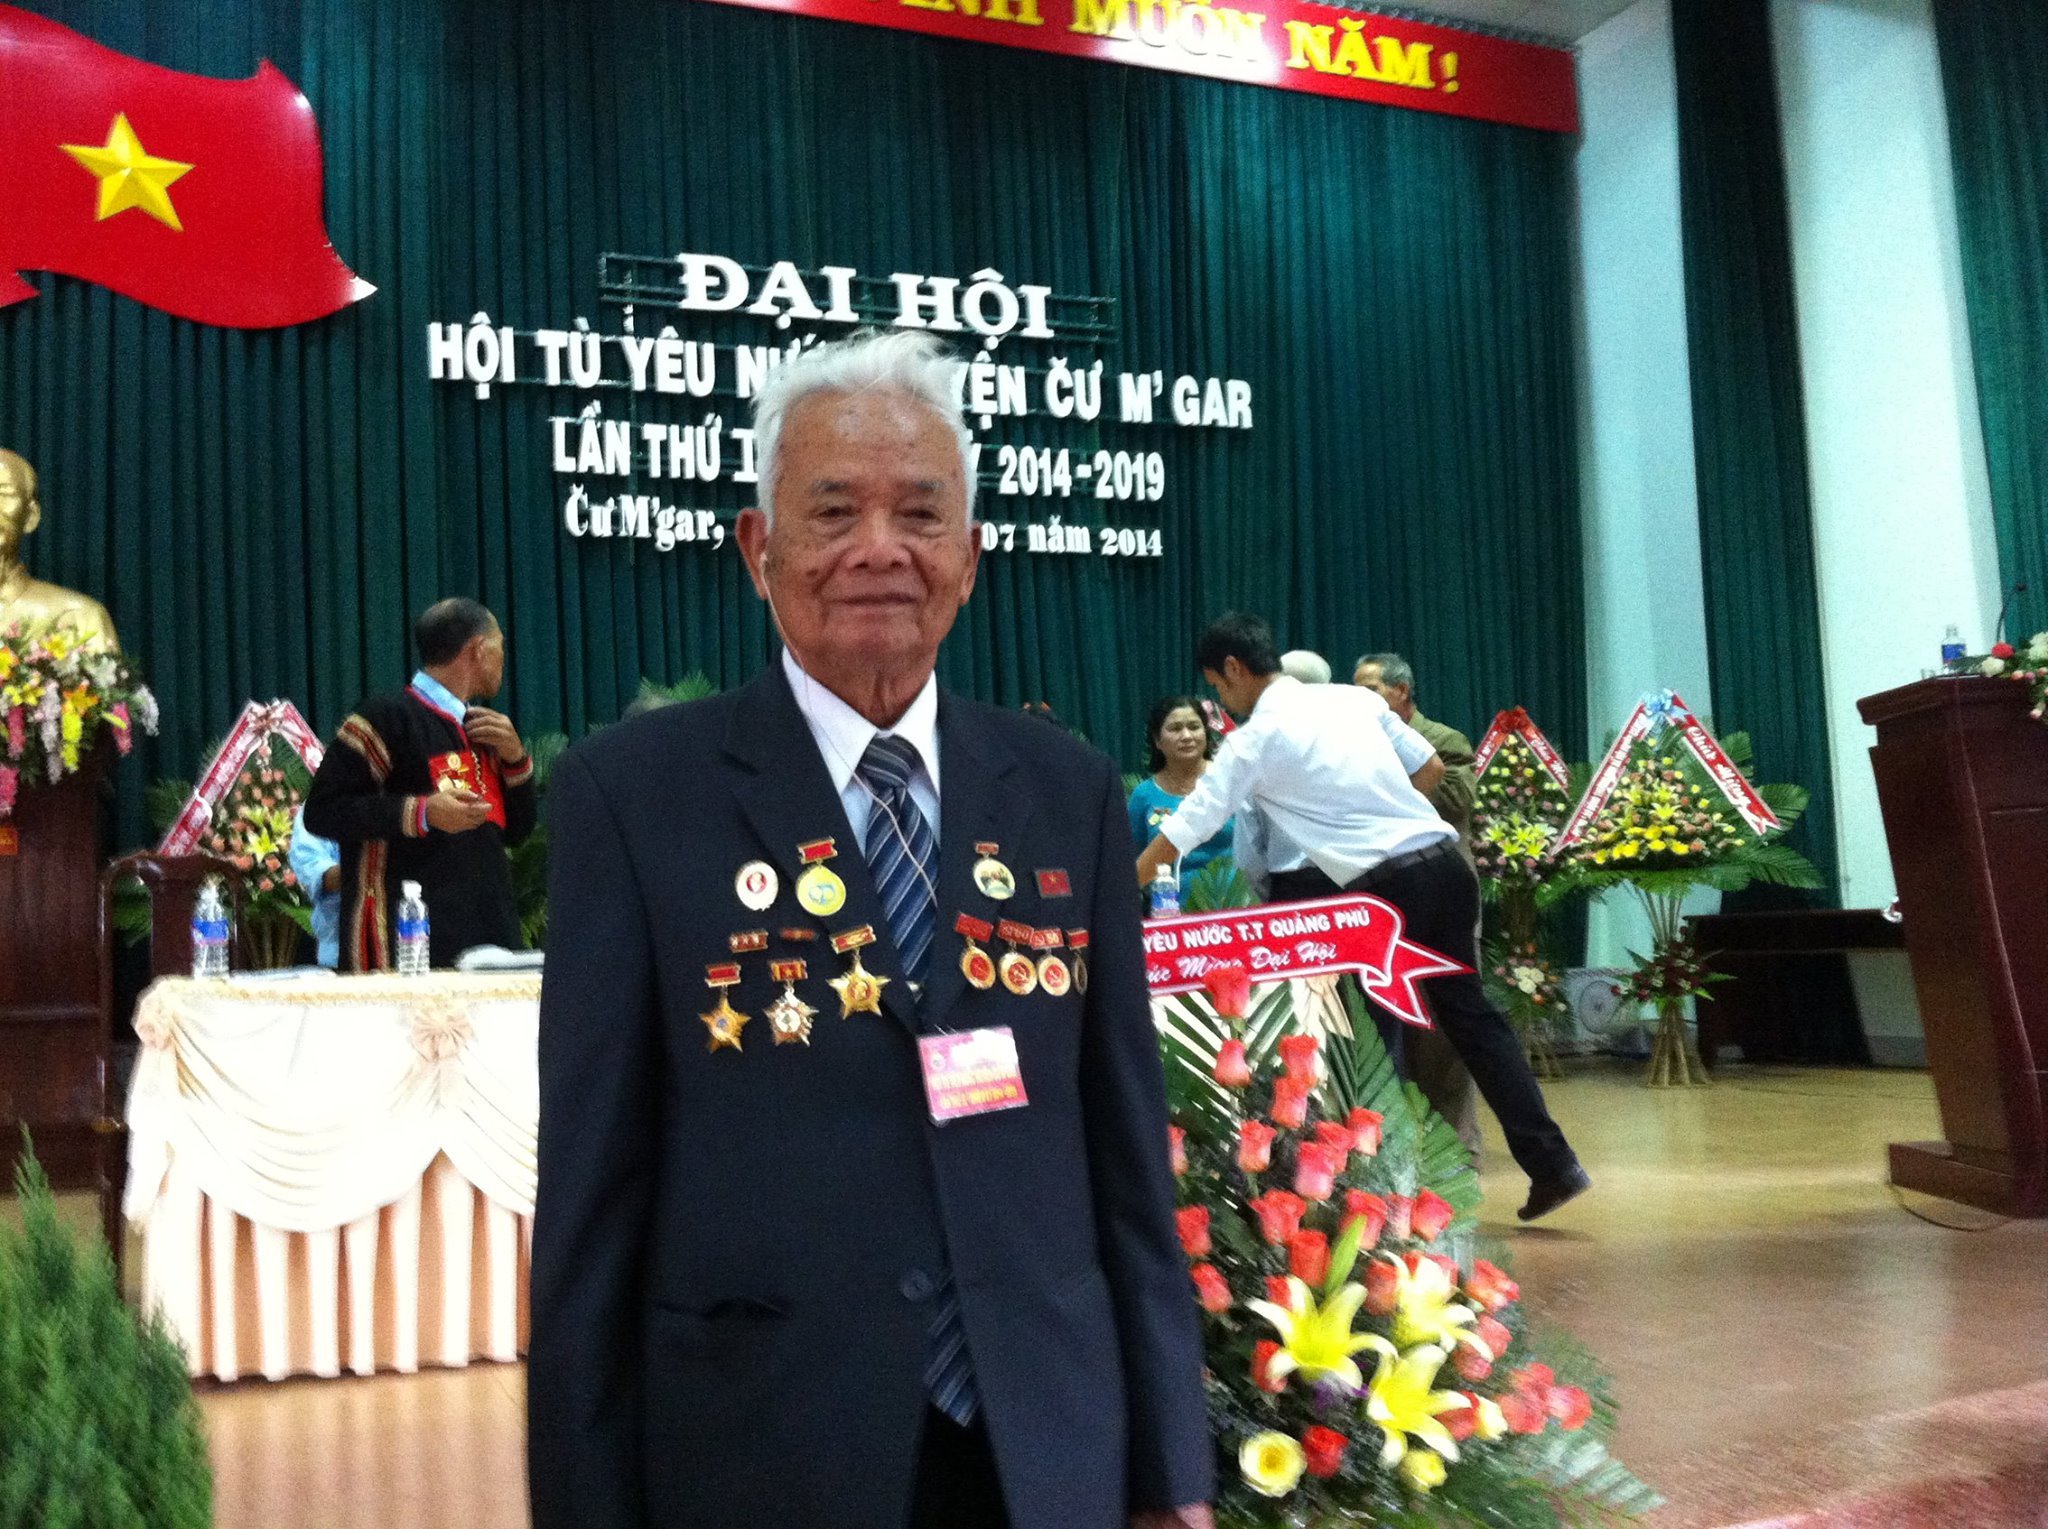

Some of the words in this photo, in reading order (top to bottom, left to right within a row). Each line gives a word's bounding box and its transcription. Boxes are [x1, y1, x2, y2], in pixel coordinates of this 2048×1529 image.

[1283, 16, 1459, 93] NĂM!
[676, 252, 860, 330] ĐẠI
[888, 267, 1055, 350] HỘI
[427, 311, 516, 400] HỘI
[535, 316, 601, 388] TÙ
[620, 326, 716, 397] YÊU
[1045, 356, 1103, 423] ČƯ
[1171, 374, 1253, 429] GAR
[553, 399, 631, 476] LẦN
[640, 413, 723, 482] THỨ
[998, 444, 1165, 501] 2014-2019
[1028, 514, 1093, 553] năm
[1099, 527, 1164, 556] 2014
[1182, 923, 1233, 949] NƯỚC
[1333, 905, 1370, 929] PHÚ
